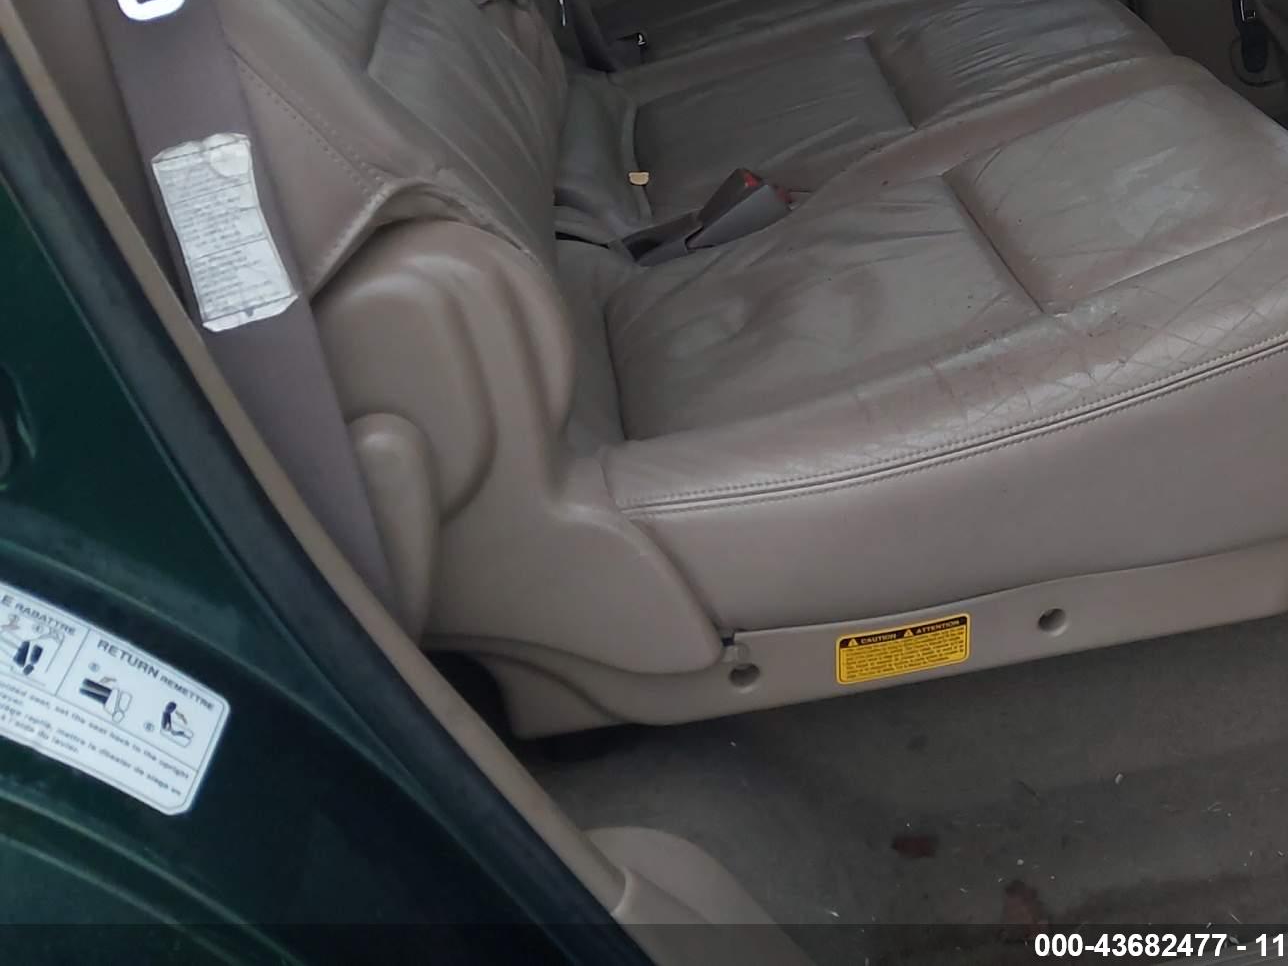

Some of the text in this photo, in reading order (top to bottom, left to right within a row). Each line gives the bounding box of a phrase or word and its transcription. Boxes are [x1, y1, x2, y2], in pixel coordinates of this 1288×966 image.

[860, 619, 960, 645] CAUTION ATTENTION
[97, 639, 215, 712] RETURN REMETTRE
